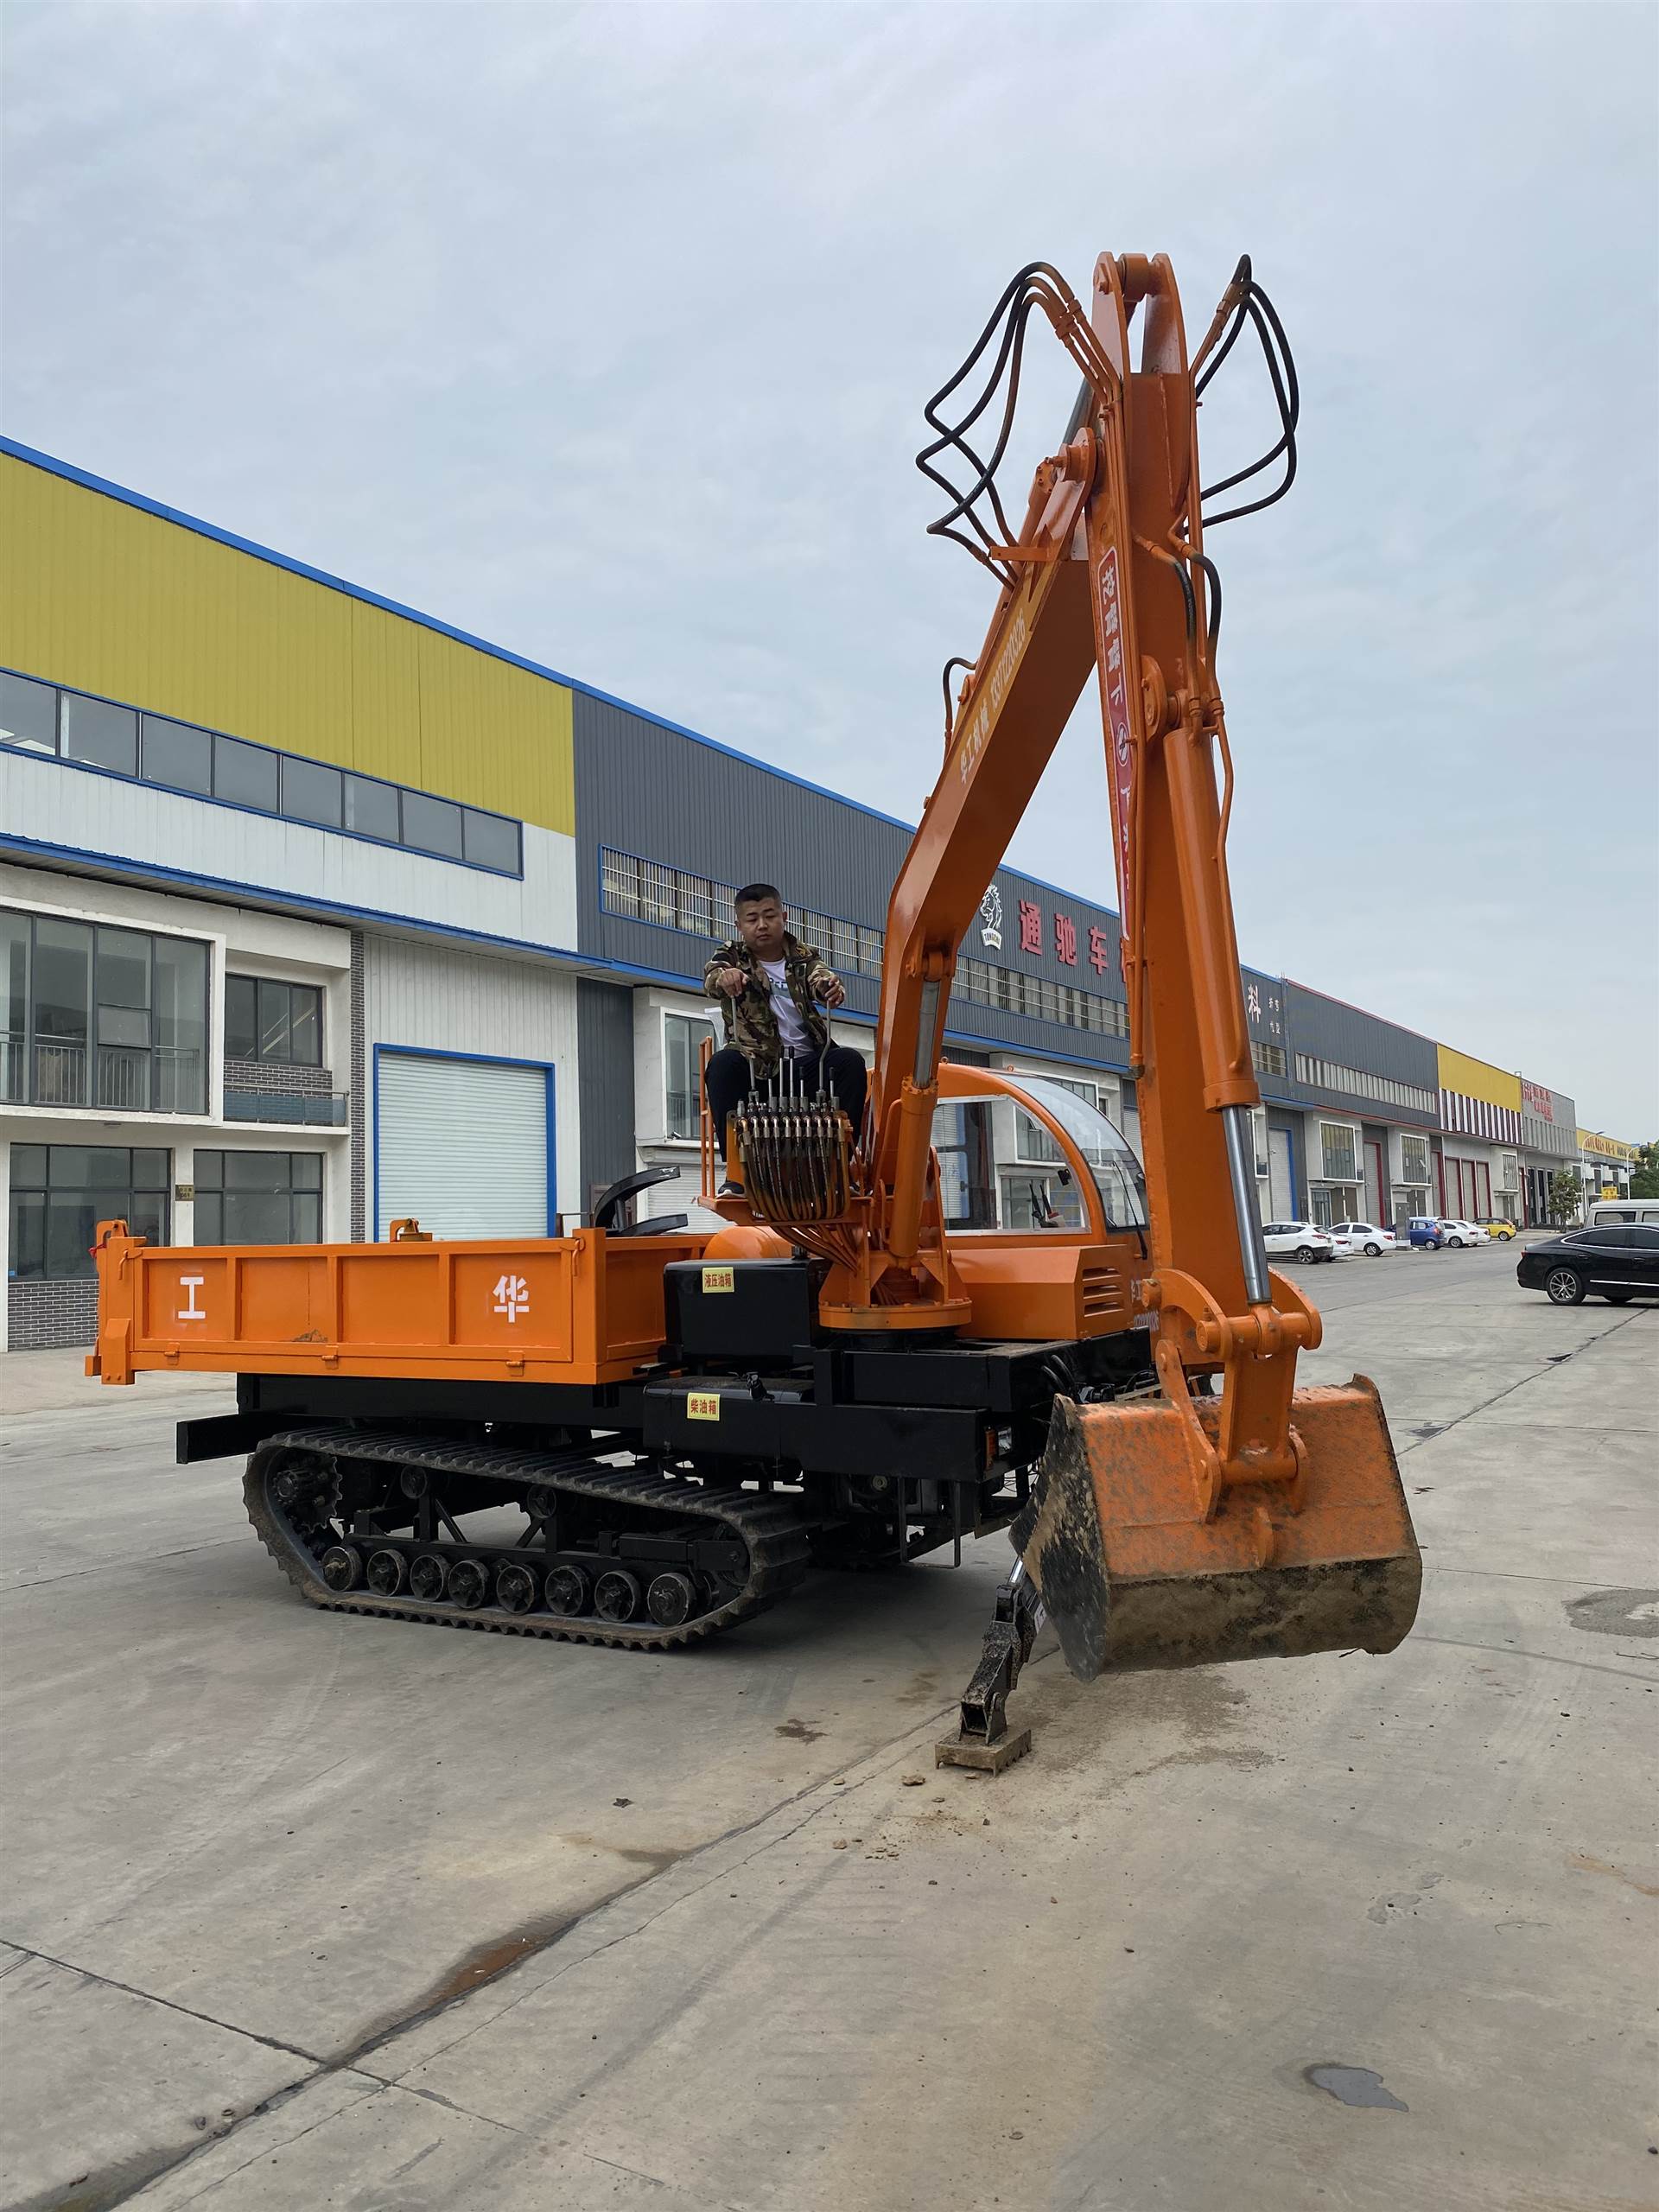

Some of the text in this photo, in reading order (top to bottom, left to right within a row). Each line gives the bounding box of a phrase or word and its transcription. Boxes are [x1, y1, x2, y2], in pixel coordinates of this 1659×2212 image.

[1018, 899, 1127, 982] 通驰车
[704, 1273, 732, 1288] 液压油箱
[178, 1274, 531, 1324] 工 华
[690, 1398, 717, 1414] 柴油箱
